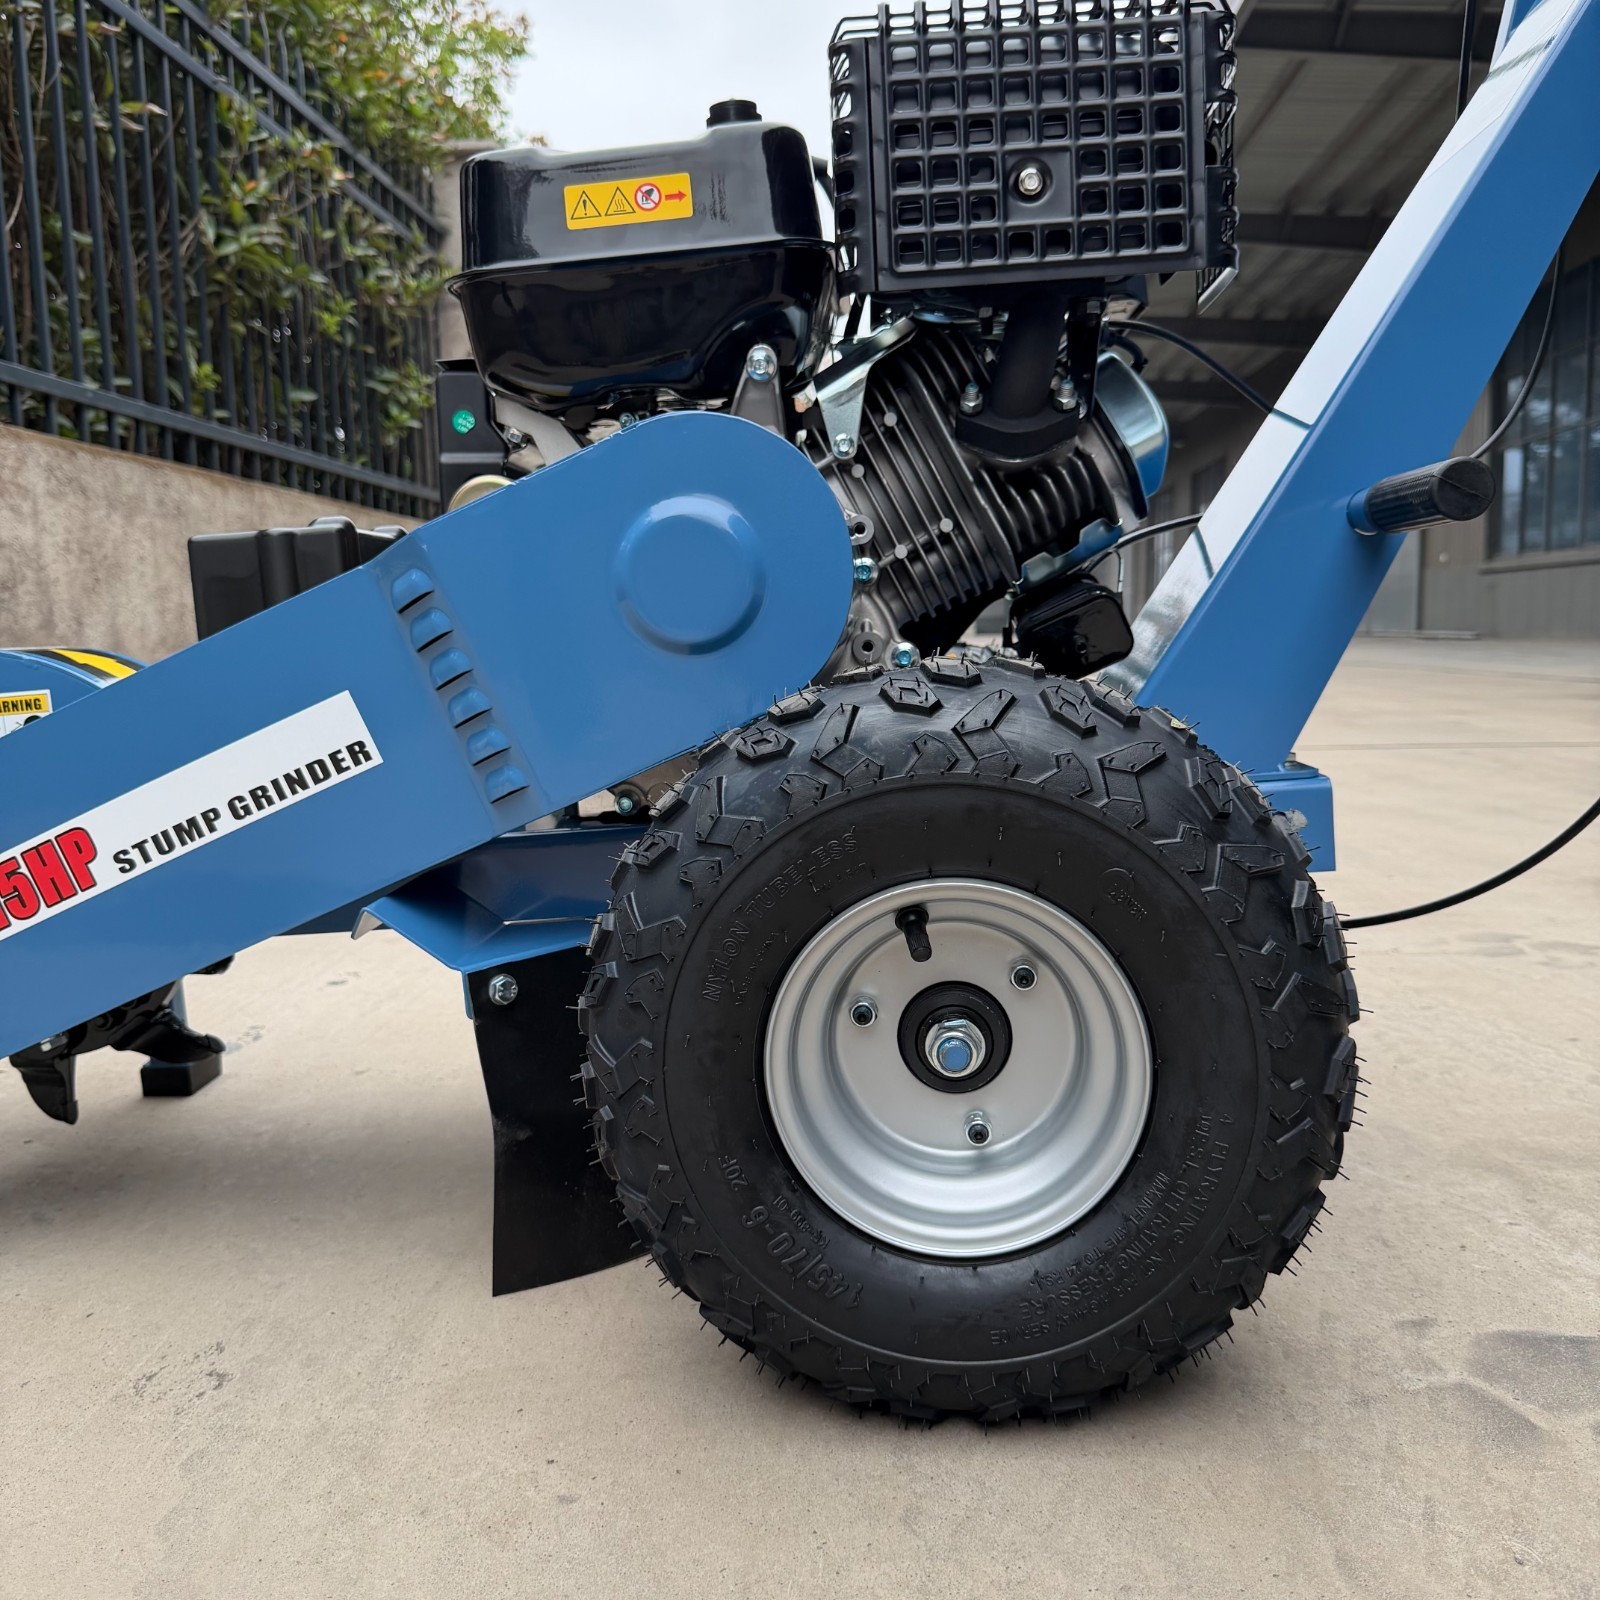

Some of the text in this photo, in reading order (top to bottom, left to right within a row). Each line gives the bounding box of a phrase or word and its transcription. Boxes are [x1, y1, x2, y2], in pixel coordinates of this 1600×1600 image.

[0, 698, 42, 713] RNING
[113, 807, 220, 873] STUMP
[228, 740, 373, 820] GRINDER
[703, 920, 750, 1001] NYLON
[744, 833, 857, 919] TUBELESS
[742, 1205, 864, 1310] 145/70-6
[1082, 1246, 1105, 1266] TO
[1118, 1179, 1190, 1270] OPERATING
[1019, 1264, 1115, 1318] PRESSURE
[990, 1318, 1050, 1345] SERVICE
